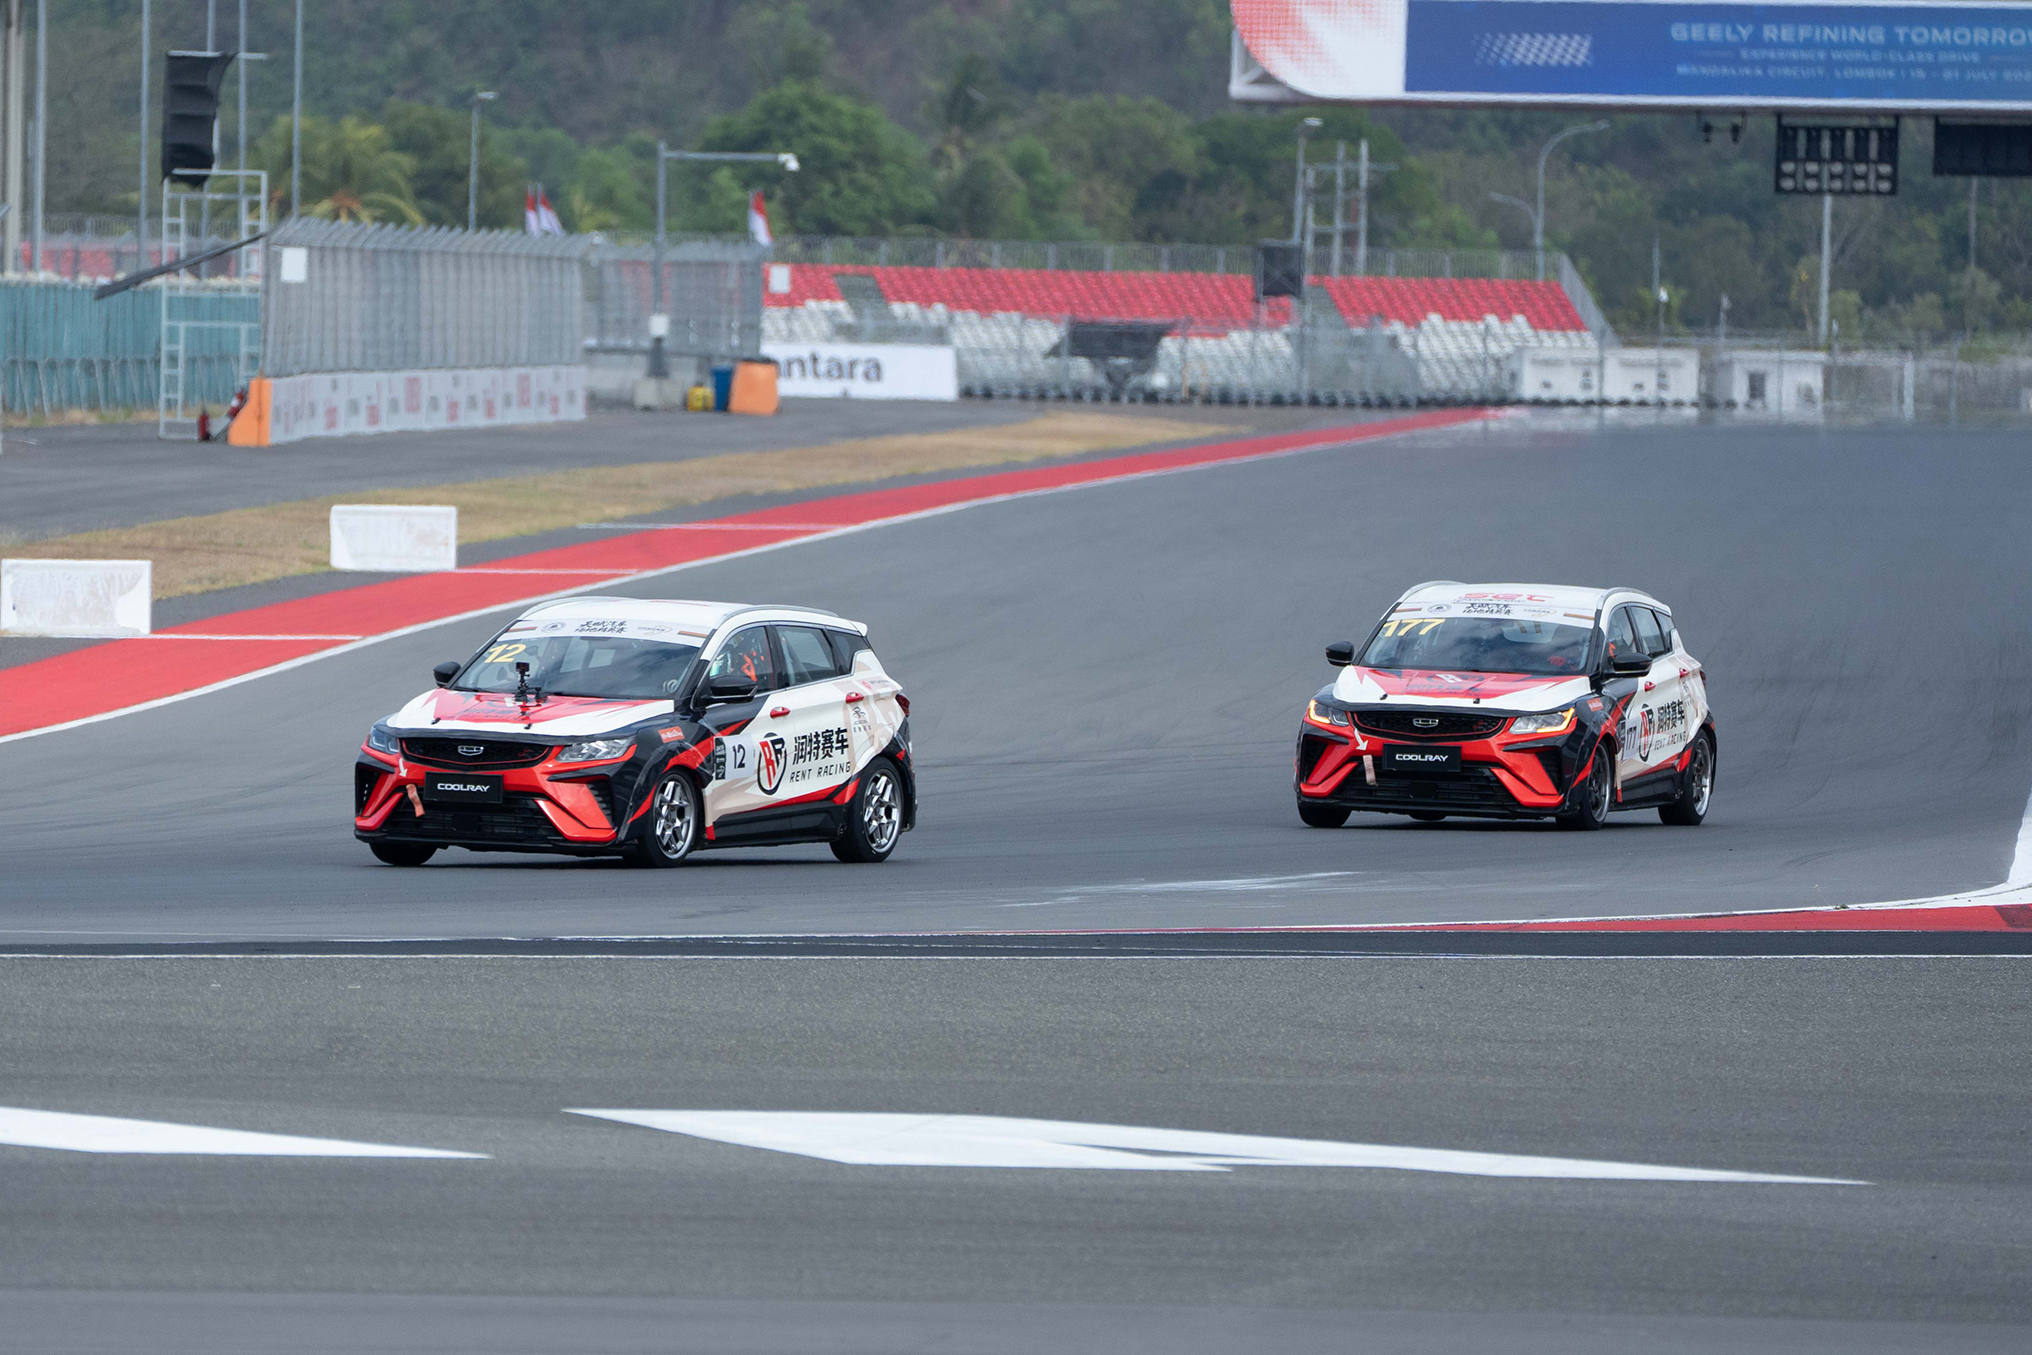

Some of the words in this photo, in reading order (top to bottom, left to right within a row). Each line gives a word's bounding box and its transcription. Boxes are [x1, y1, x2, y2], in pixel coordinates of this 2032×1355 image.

[1671, 22, 1753, 42] GEELY
[1762, 24, 1886, 44] REFINING
[1894, 26, 2032, 46] TOMORRO
[1740, 48, 1827, 61] EXPERIENCE
[1938, 50, 1981, 64] DRIVE
[1834, 66, 1896, 79] LOMBOK
[778, 352, 881, 382] ntara
[1384, 618, 1446, 637] 177
[484, 644, 526, 663] 12
[793, 728, 849, 765] 润特赛车
[732, 743, 746, 770] 12
[1395, 753, 1449, 762] COOLRAY
[789, 768, 812, 783] RENT
[817, 761, 851, 778] RACING
[437, 782, 490, 792] COOLRAY
